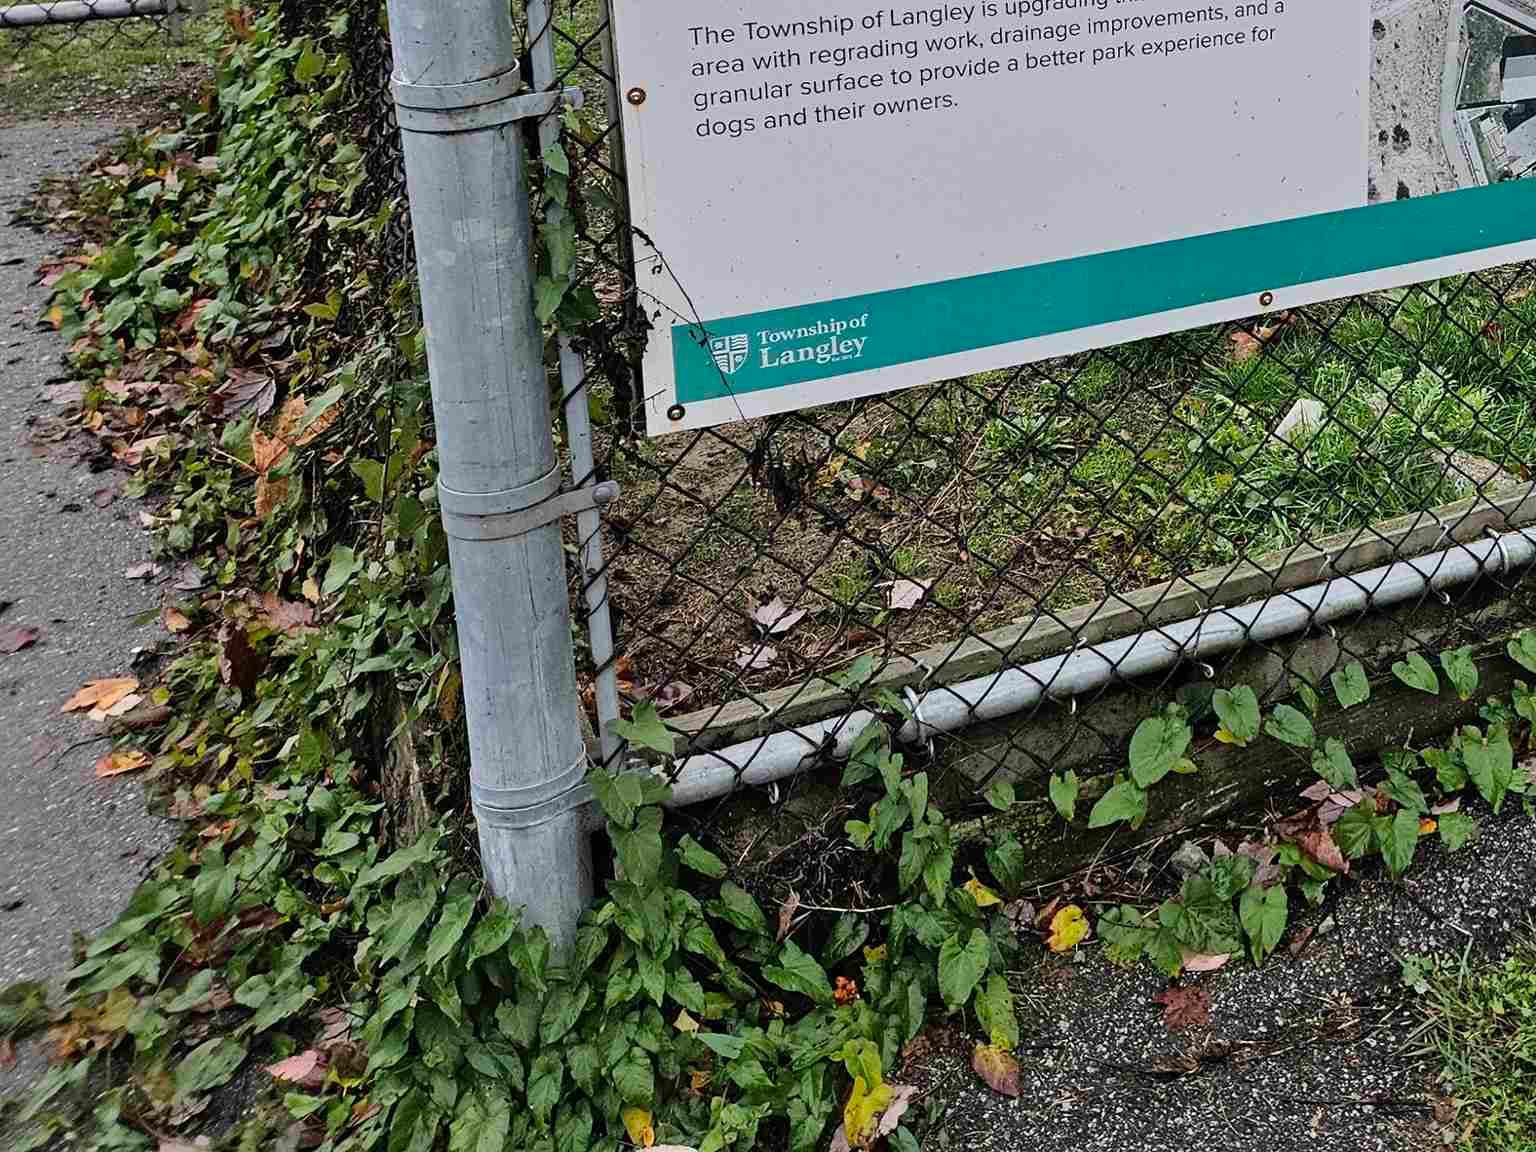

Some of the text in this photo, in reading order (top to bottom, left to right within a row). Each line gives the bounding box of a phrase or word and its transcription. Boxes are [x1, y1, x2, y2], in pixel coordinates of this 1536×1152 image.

[688, 26, 736, 46] The
[743, 15, 854, 41] Township
[862, 10, 884, 29] of
[890, 4, 975, 27] Langley
[982, 0, 997, 17] is
[691, 0, 1285, 77] area with regrading work, drainage improvements, and a
[694, 26, 1276, 111] granular surface to provide a better park experience for
[696, 93, 959, 138] dogs and their owners.
[757, 313, 868, 345] Township of
[759, 335, 868, 368] Langley
